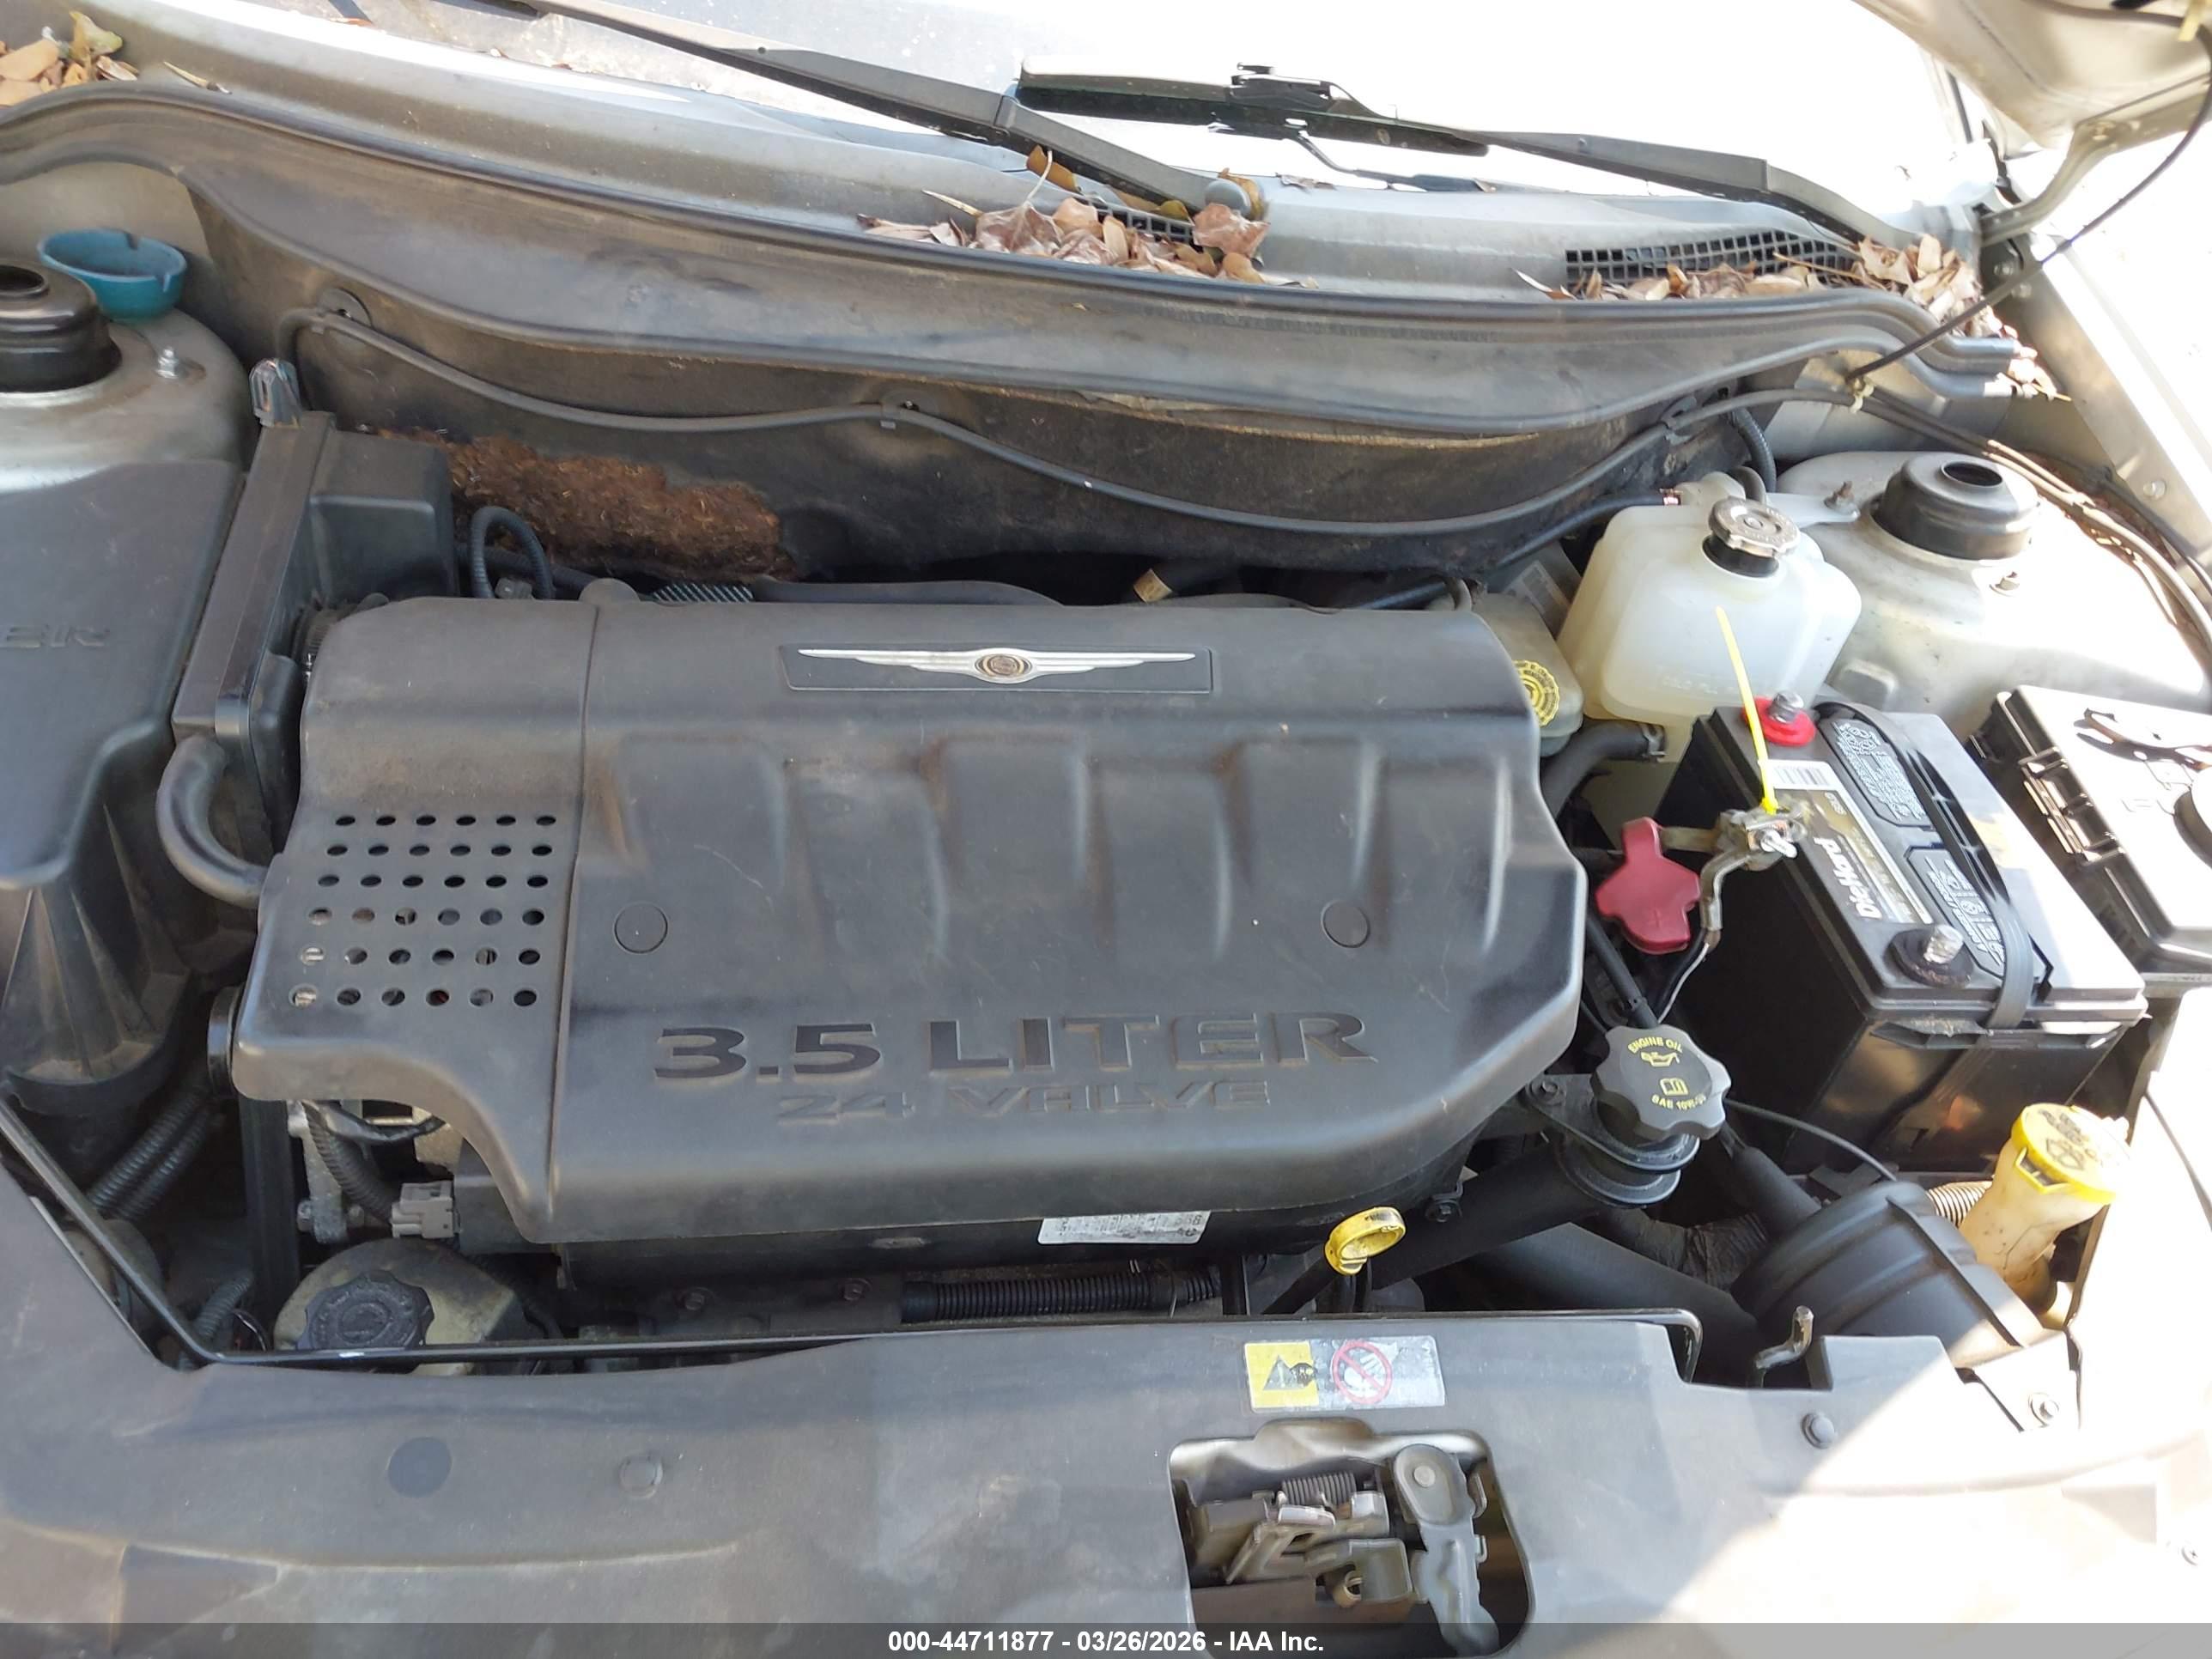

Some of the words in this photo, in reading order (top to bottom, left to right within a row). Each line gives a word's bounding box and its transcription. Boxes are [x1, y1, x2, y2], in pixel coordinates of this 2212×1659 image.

[1814, 836, 1883, 921] DieHard
[653, 1023, 883, 1084] 3.5
[927, 1012, 1378, 1077] LITER
[1627, 1036, 1664, 1054] ENGINE
[1665, 1038, 1683, 1054] OIL
[776, 1091, 907, 1126] 24
[947, 1080, 1271, 1118] VALVE
